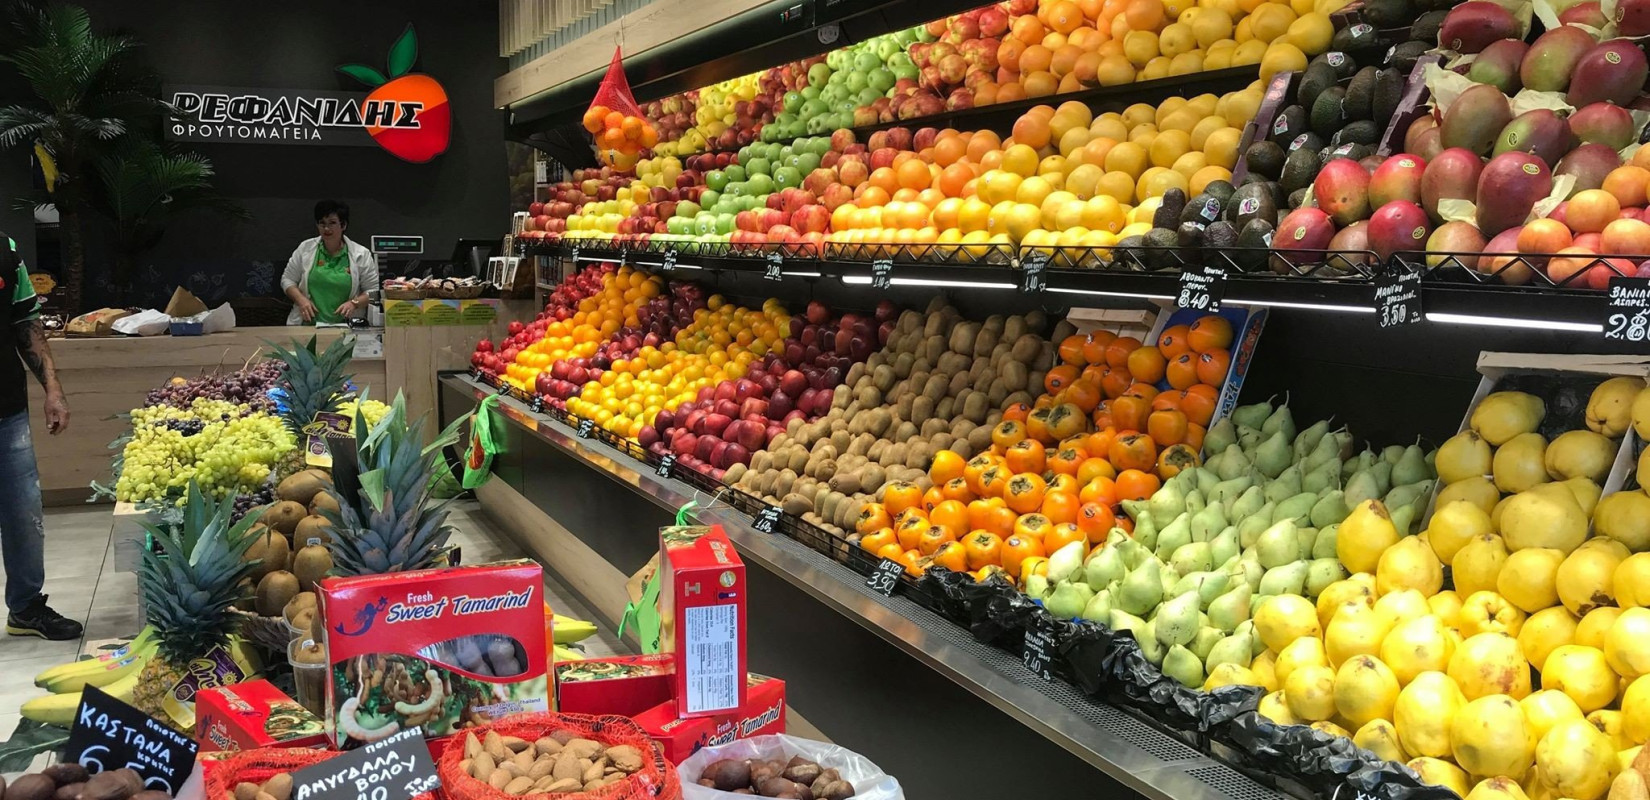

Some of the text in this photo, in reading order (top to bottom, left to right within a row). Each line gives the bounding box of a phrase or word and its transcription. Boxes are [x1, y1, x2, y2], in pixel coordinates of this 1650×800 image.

[172, 124, 322, 140] ΦΡΟΥΤΟΜΑΓΕΙΑ
[1380, 304, 1407, 328] 3.50
[385, 585, 534, 624] Sweet Tamarind
[407, 591, 433, 604] Fresh
[80, 701, 171, 764] ΚΑΣΤΑΝΑ
[717, 720, 732, 735] Fresh
[741, 698, 783, 738] Tamarind
[297, 750, 399, 800] ΑΜΥΓΔΑΛΑ
[355, 754, 416, 792] ΒΟΛΟΥ
